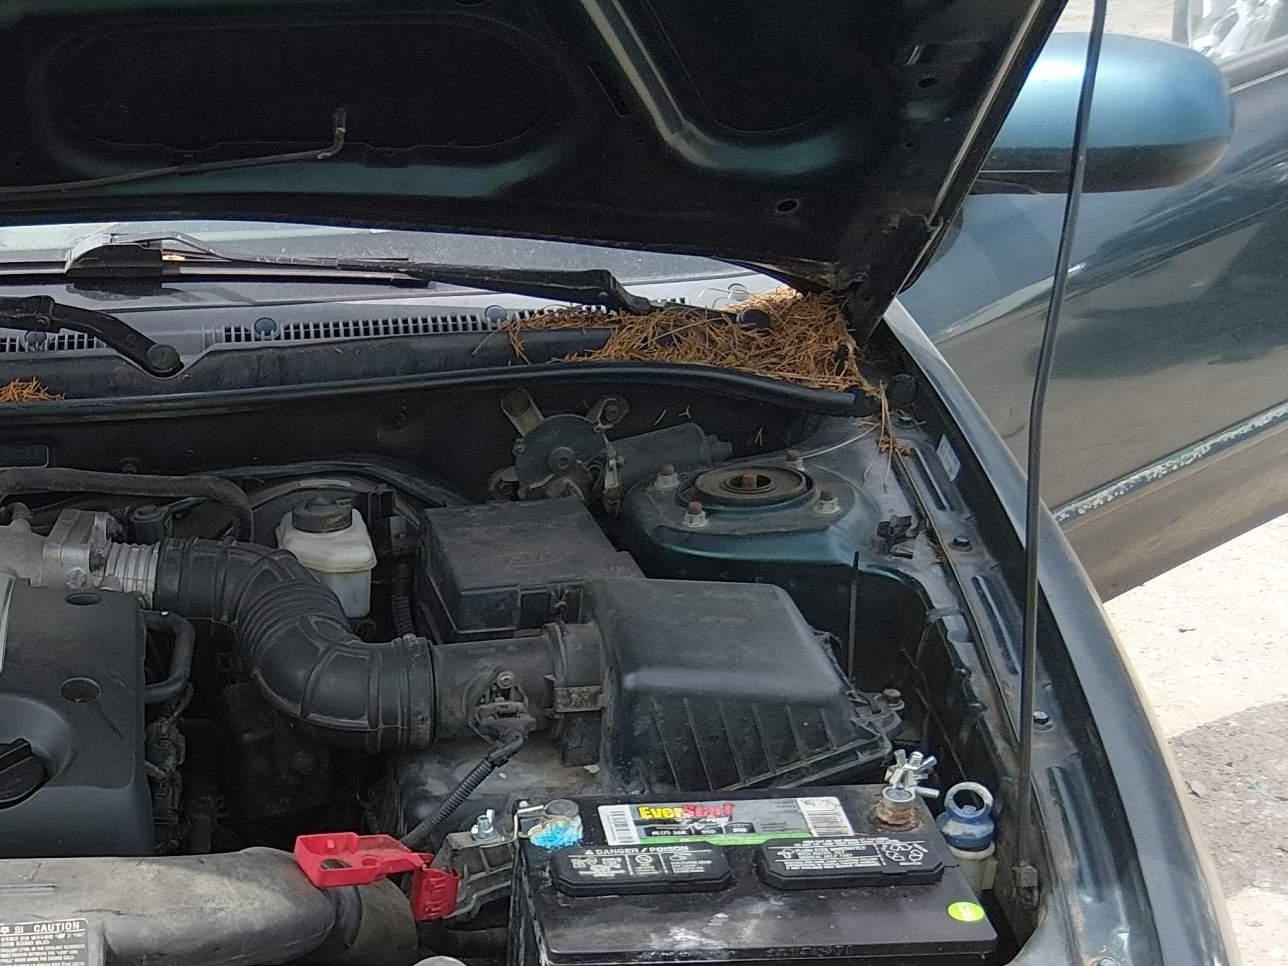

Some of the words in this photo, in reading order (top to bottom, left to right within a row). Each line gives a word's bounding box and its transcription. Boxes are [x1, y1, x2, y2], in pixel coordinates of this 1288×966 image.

[638, 802, 735, 820] EverStart
[595, 847, 639, 855] DANGER
[33, 922, 80, 933] CAUTION
